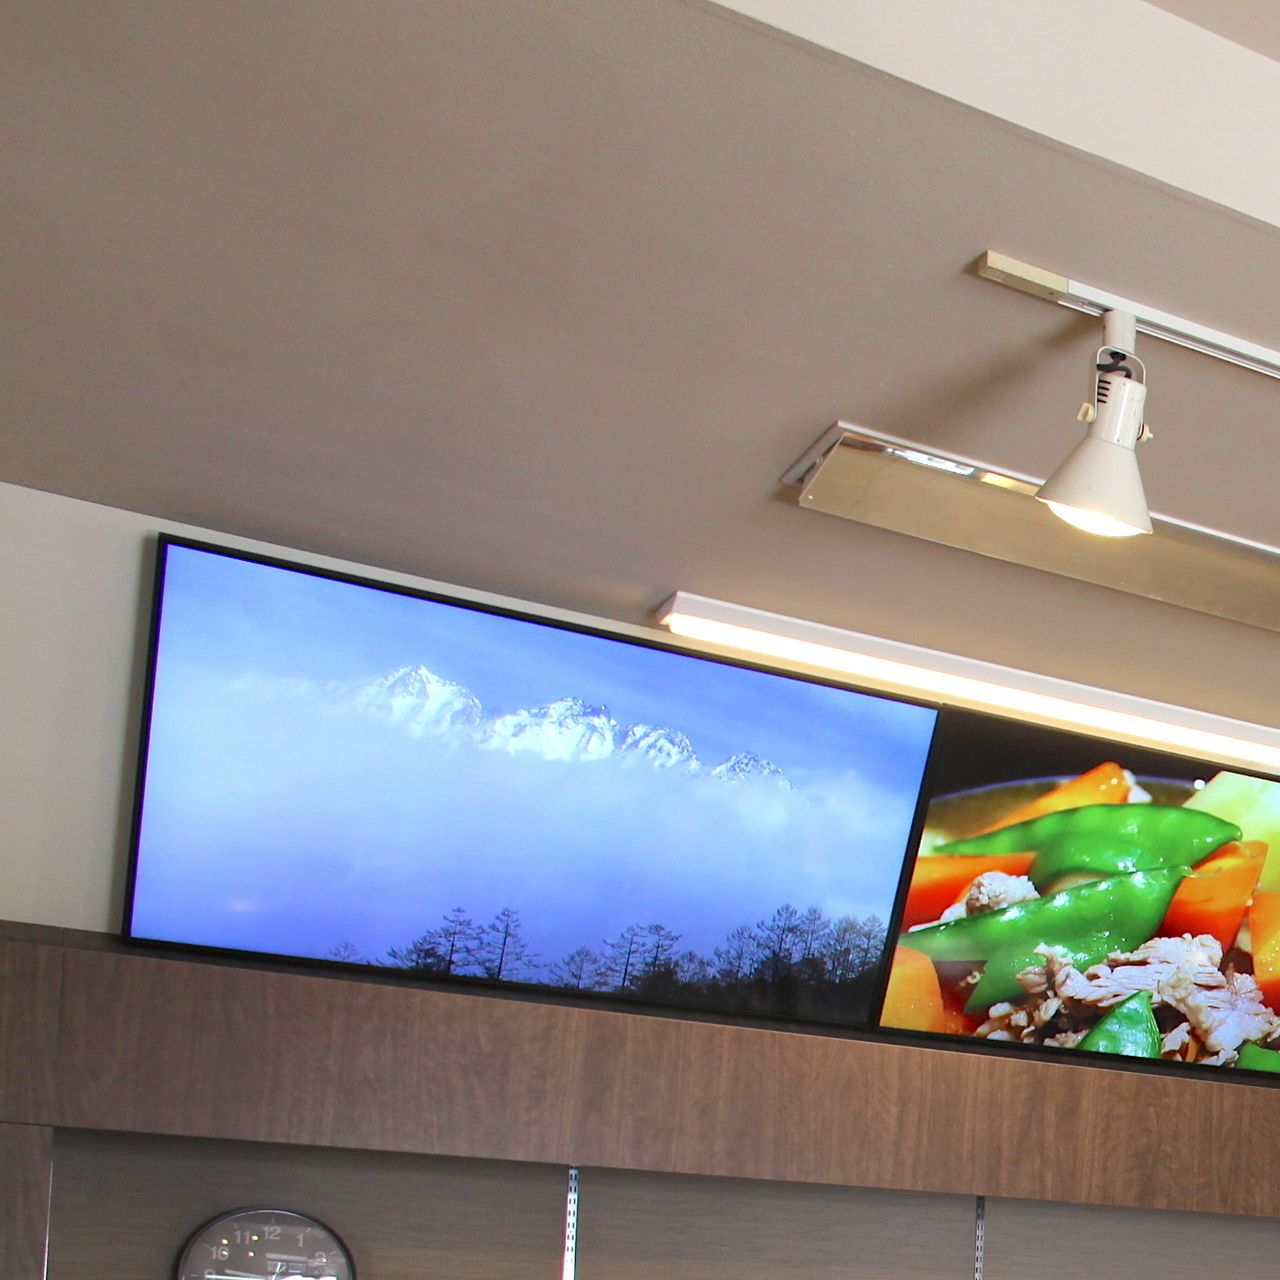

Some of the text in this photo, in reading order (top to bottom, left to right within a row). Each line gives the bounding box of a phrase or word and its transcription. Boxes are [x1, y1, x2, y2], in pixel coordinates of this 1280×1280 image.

[234, 1231, 250, 1244] 11
[264, 1225, 281, 1241] 12
[296, 1234, 304, 1247] 1
